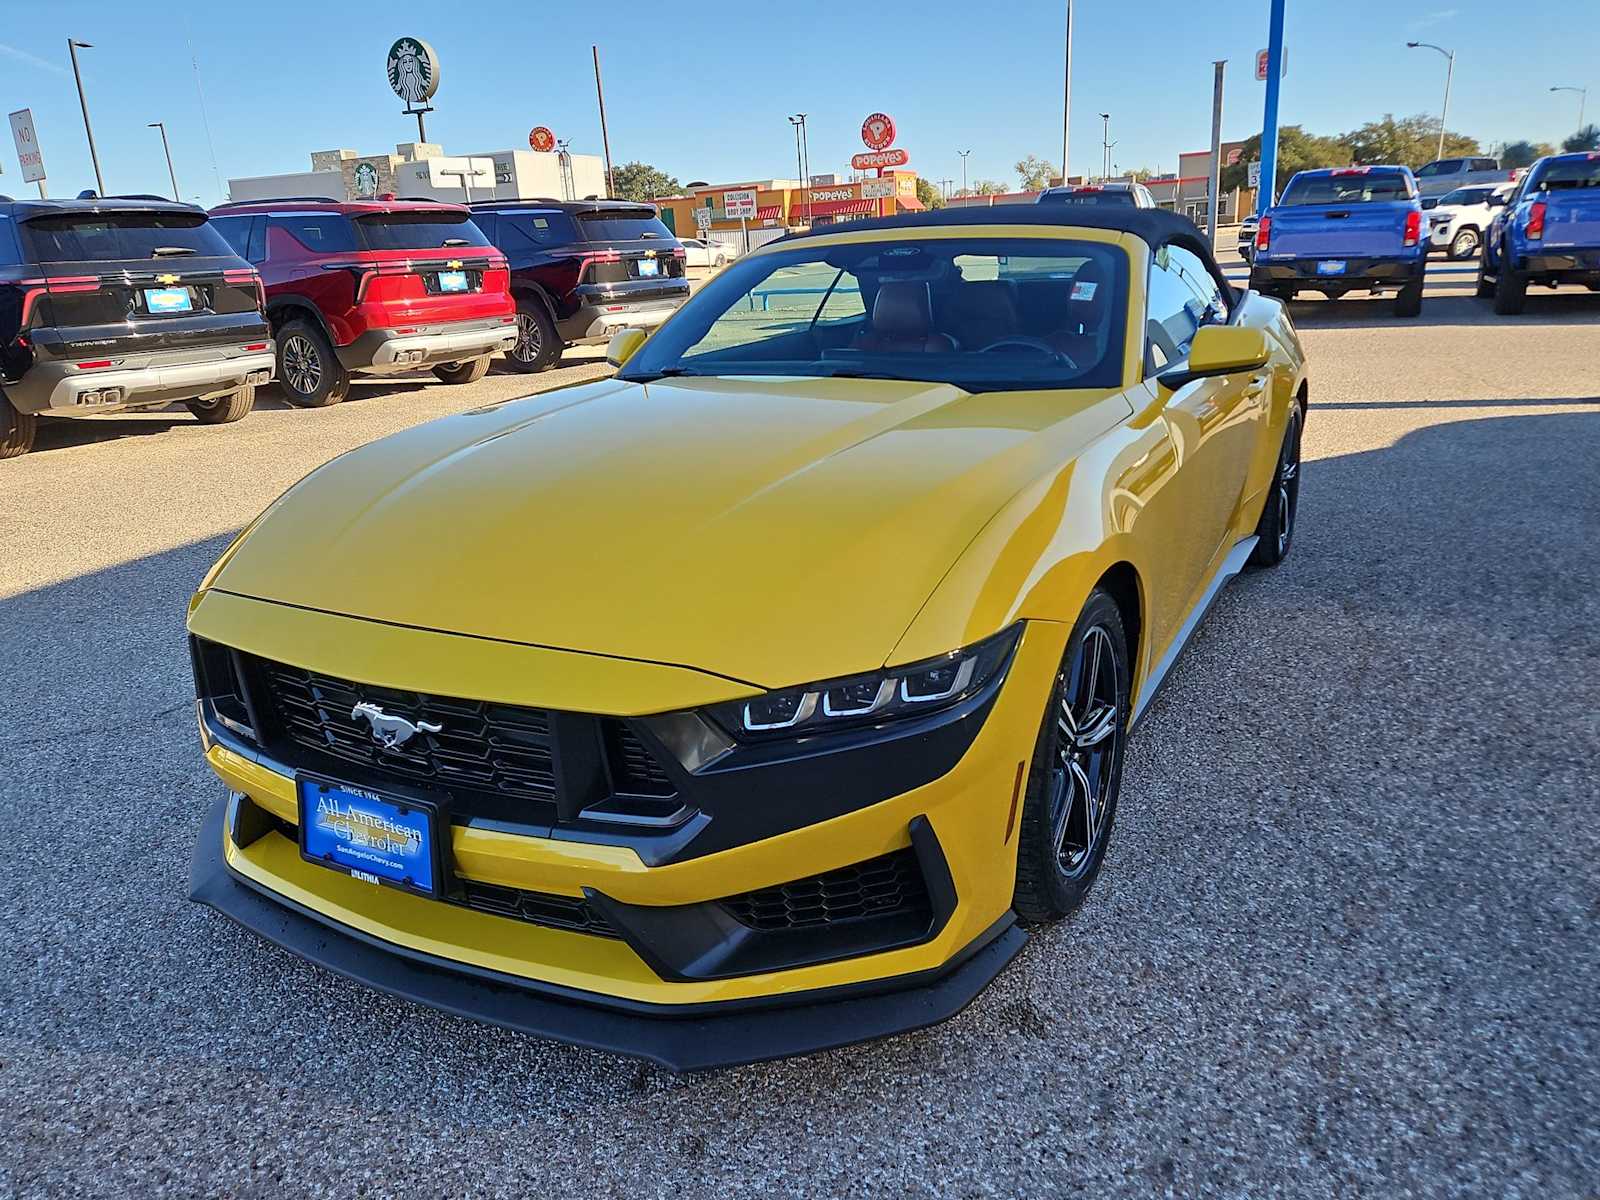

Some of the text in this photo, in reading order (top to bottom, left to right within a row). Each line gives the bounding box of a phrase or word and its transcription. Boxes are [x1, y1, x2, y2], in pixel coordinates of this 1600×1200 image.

[18, 127, 31, 144] NO
[869, 121, 886, 140] P
[20, 151, 41, 167] PARKING
[727, 192, 750, 201] COLLISION
[727, 207, 751, 216] BODY SHOP
[699, 219, 710, 227] 35
[70, 339, 117, 348] TRAVERSE
[340, 785, 364, 798] SINCE
[316, 797, 423, 842] All American
[333, 820, 406, 857] Chevrolet
[336, 844, 404, 870] SanAngeloChevy.com
